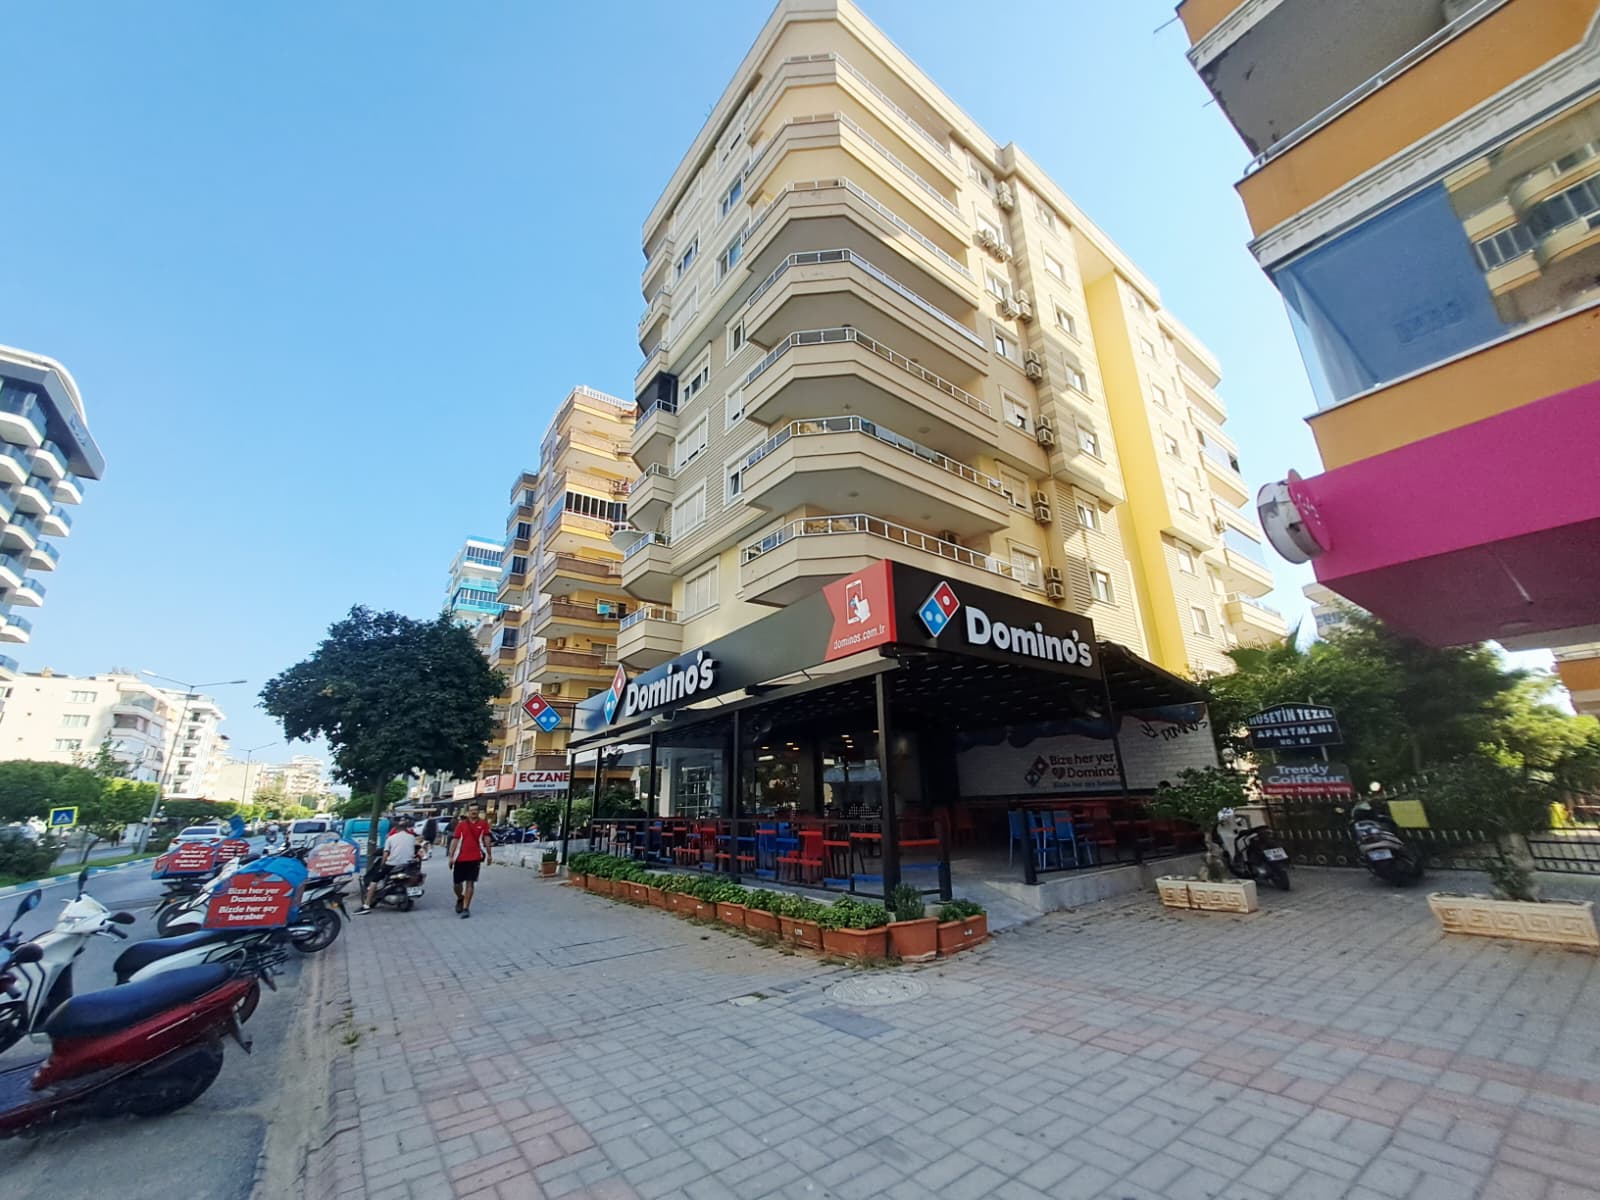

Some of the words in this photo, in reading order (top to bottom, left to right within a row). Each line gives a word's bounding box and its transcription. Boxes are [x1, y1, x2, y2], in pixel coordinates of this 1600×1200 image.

[965, 605, 1093, 668] Domino's
[625, 650, 714, 717] Domino's
[1296, 709, 1333, 720] TEZEL
[1257, 724, 1333, 738] APARTMANI
[1074, 753, 1093, 764] her
[1096, 753, 1114, 766] yer
[1276, 763, 1329, 776] Trendy
[519, 772, 569, 783] ECZANE
[1268, 774, 1344, 785] Coiffeur
